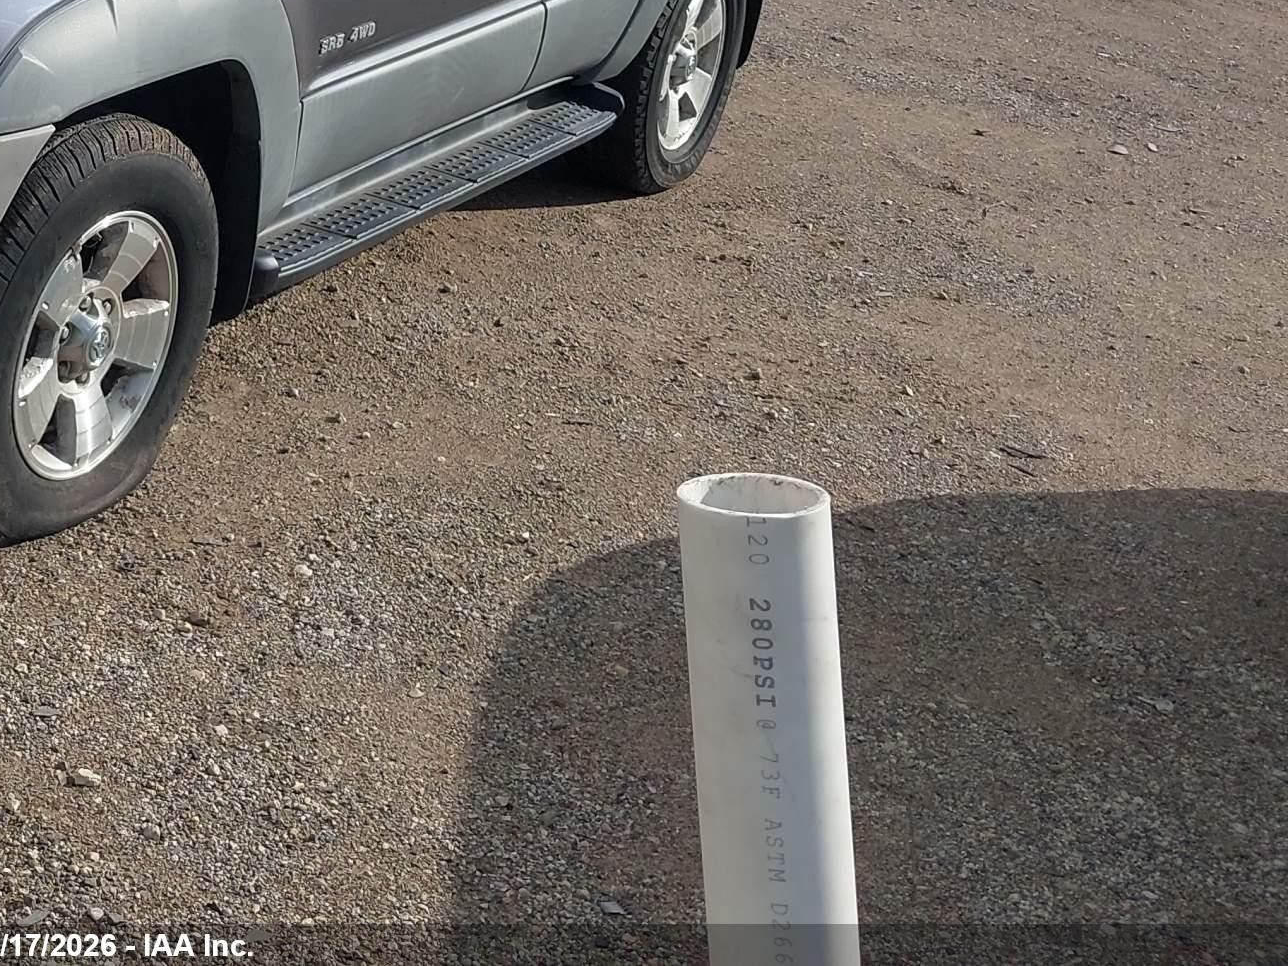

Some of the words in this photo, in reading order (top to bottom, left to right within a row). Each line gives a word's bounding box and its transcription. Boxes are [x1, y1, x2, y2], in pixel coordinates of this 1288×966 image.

[350, 22, 376, 42] 4WD
[744, 515, 770, 565] 120
[749, 597, 777, 708] 280PSI
[760, 752, 781, 800] 73F
[764, 817, 787, 883] ASTM
